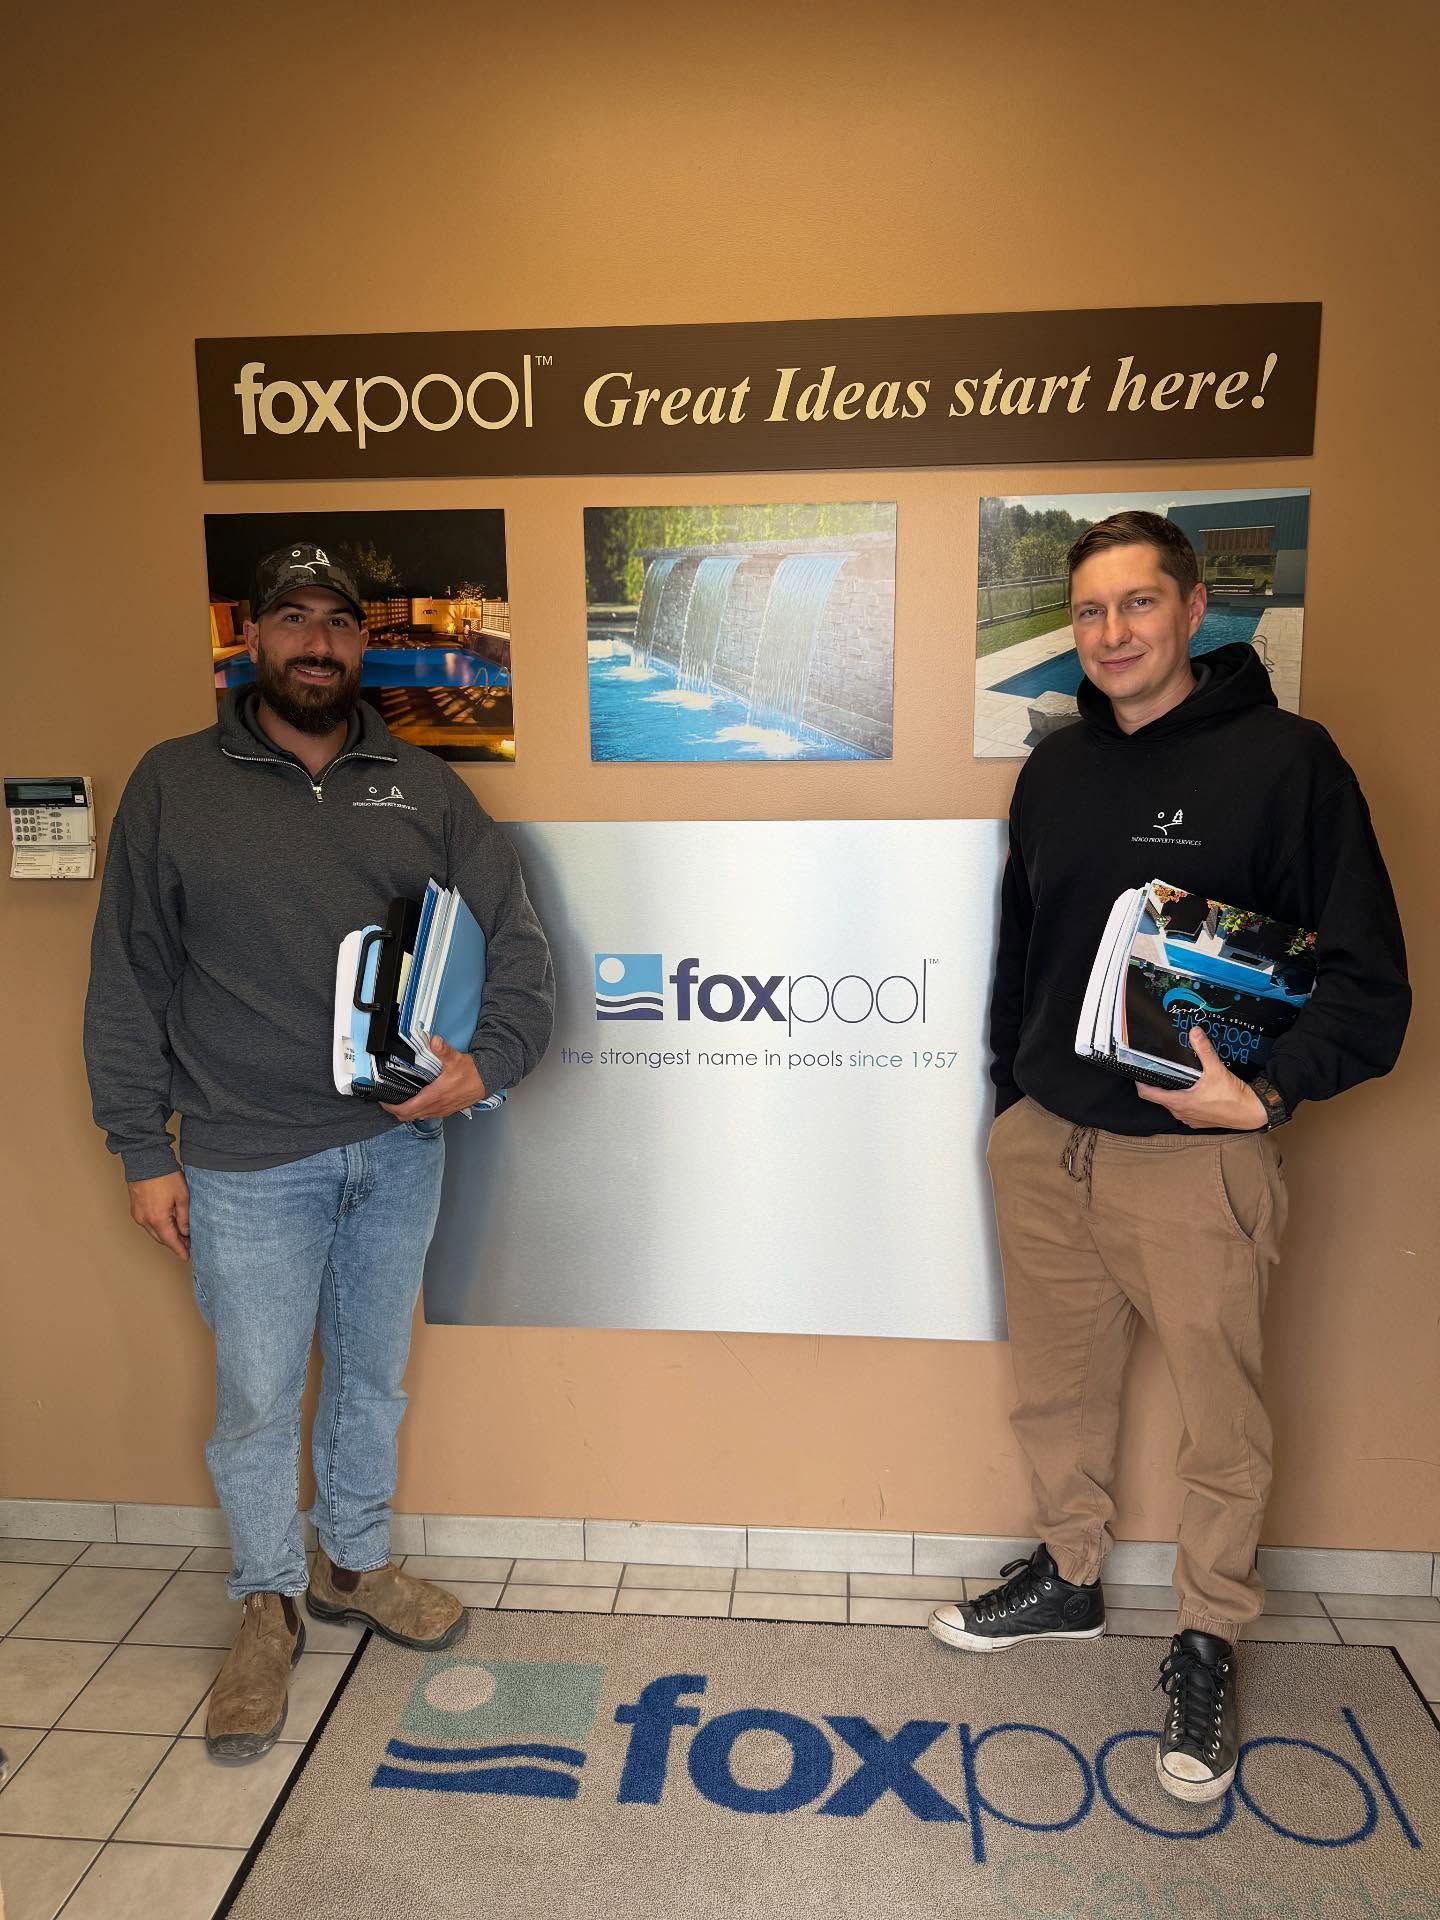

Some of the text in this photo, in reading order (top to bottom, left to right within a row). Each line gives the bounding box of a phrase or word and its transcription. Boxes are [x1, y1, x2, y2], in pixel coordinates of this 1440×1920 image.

[234, 355, 533, 449] foxpool
[583, 371, 750, 428] Great
[763, 365, 931, 423] Ideas
[948, 365, 1091, 418] start
[1106, 352, 1278, 412] here!
[669, 957, 927, 1037] foxpool
[560, 1048, 959, 1070] the strongest name in pools since 1957
[1178, 1031, 1249, 1065] BACKD
[615, 1673, 1421, 1864] foxpool
